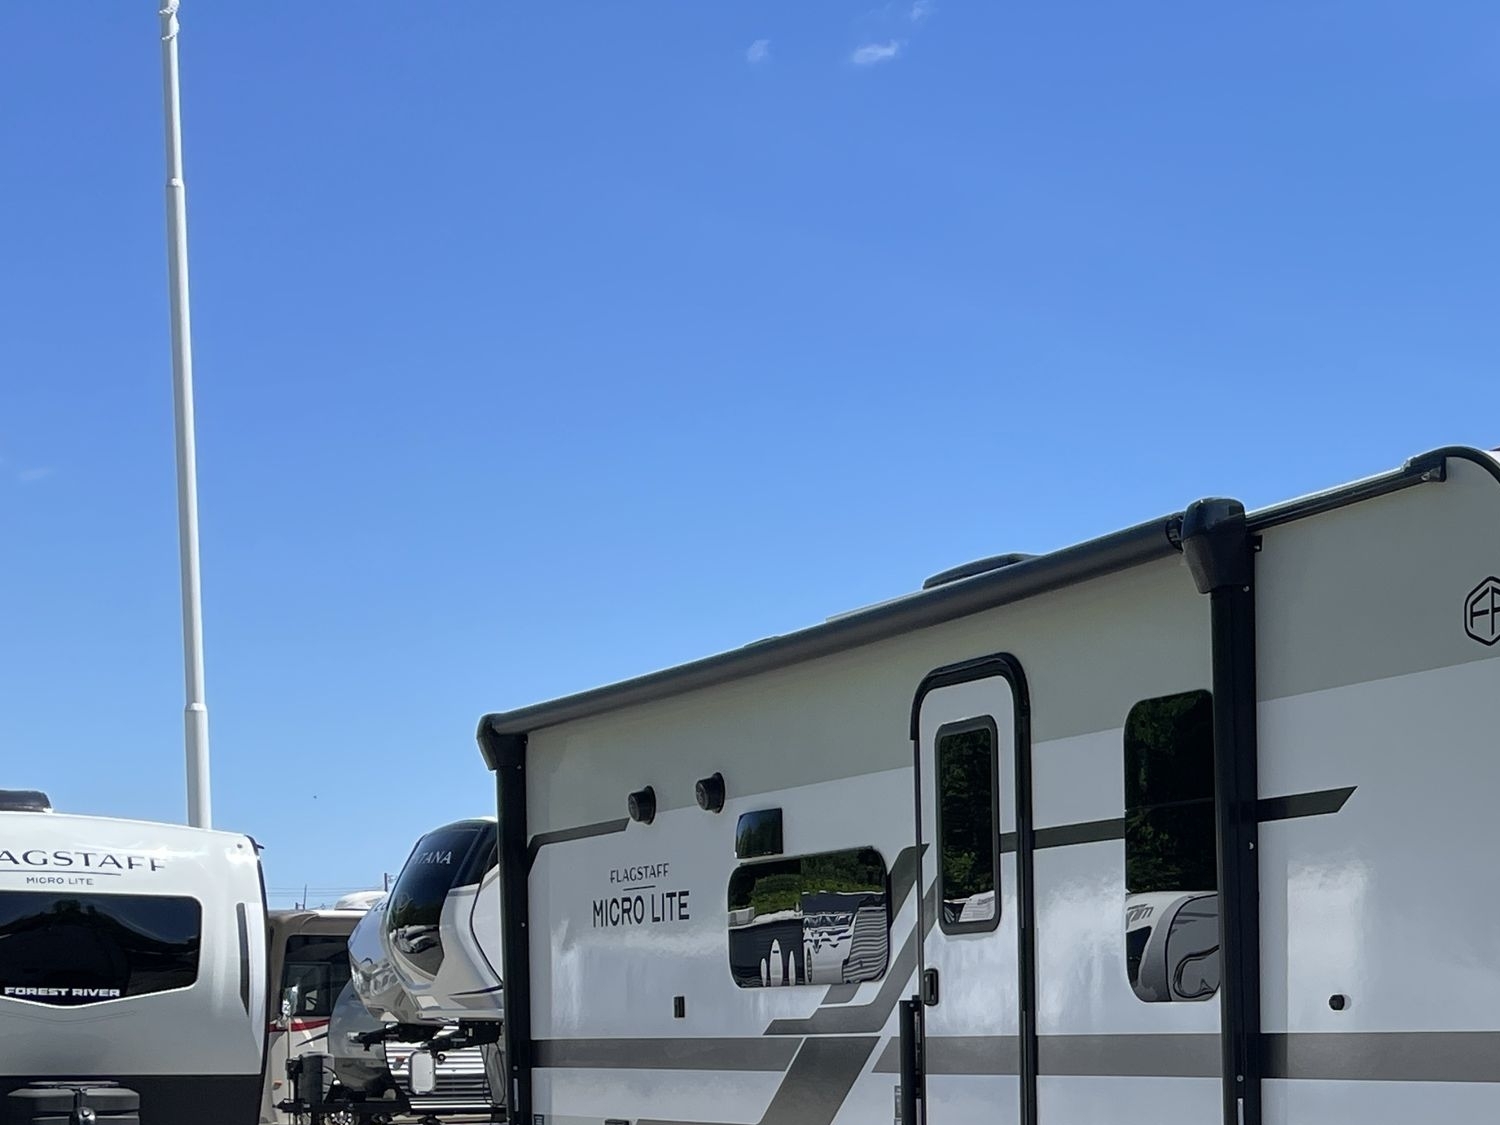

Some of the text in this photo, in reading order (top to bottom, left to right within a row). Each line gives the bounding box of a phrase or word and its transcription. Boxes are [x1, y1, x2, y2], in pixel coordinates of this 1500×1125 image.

[609, 863, 670, 883] FLAGSTAFF
[26, 877, 94, 886] MICRO LITE
[593, 890, 690, 928] MICRO LITE
[4, 986, 120, 997] FOREST RIVER
